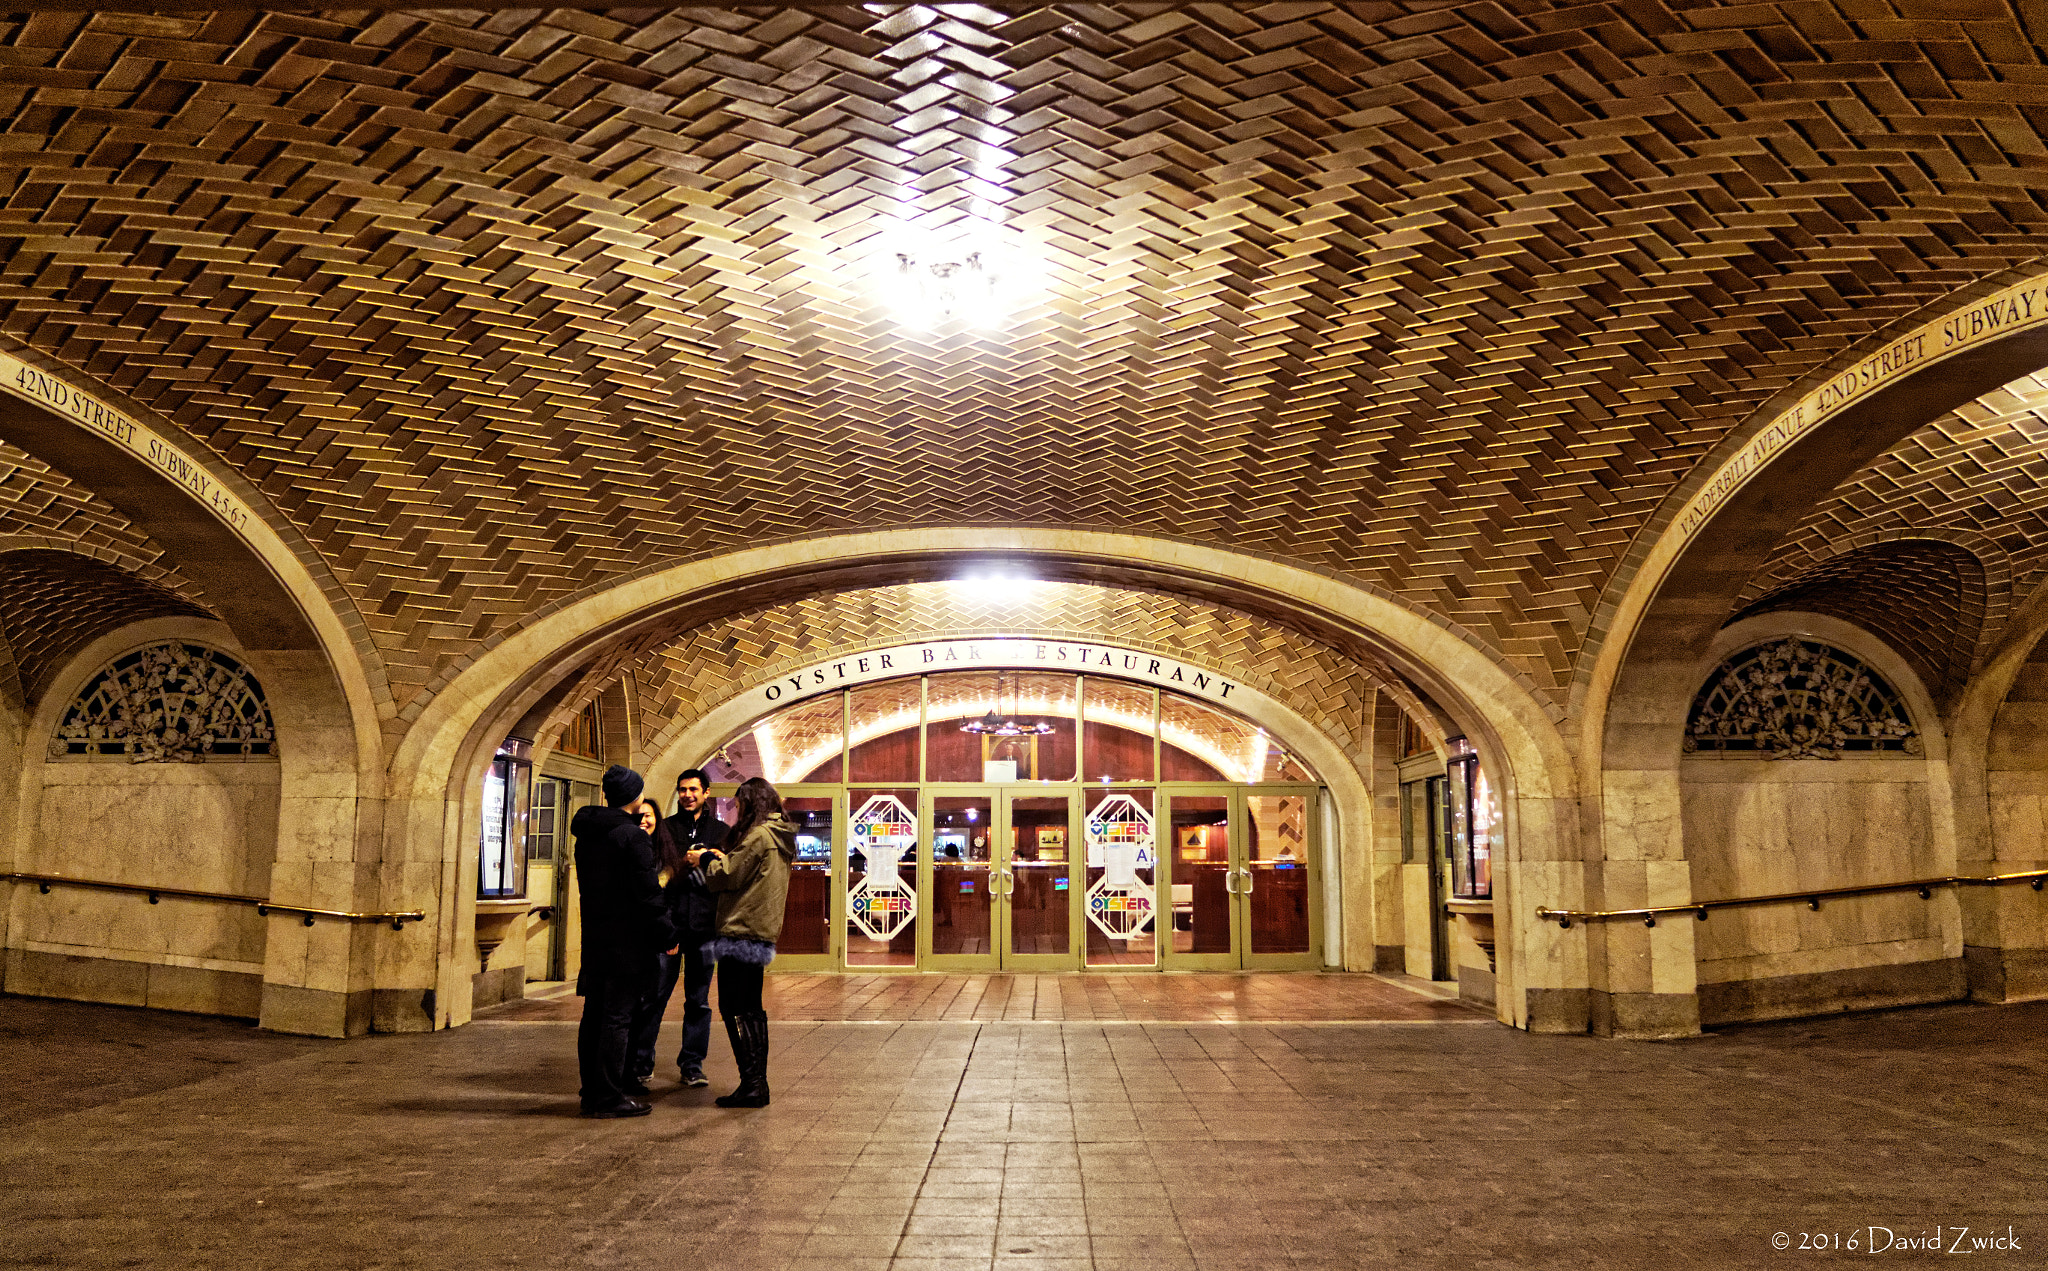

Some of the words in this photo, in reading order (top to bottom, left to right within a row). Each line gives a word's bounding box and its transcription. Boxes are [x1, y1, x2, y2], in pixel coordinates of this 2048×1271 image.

[1680, 460, 1750, 535] VANDERBILT
[1752, 407, 1805, 465] AVENUE
[1816, 376, 1858, 414] 42ND
[1861, 333, 1926, 388] STREET
[1943, 288, 2038, 347] SUBWAY
[16, 367, 68, 406] 42ND
[72, 392, 137, 445] STREET
[148, 439, 211, 497] SUBWAY
[765, 653, 895, 701] OYSTER
[922, 645, 982, 664] BAR
[854, 823, 914, 836] OYSTER
[1091, 823, 1151, 836] OYSTER
[1136, 848, 1148, 862] A
[853, 898, 913, 911] OYSTER
[1091, 897, 1152, 910] OYSTER
